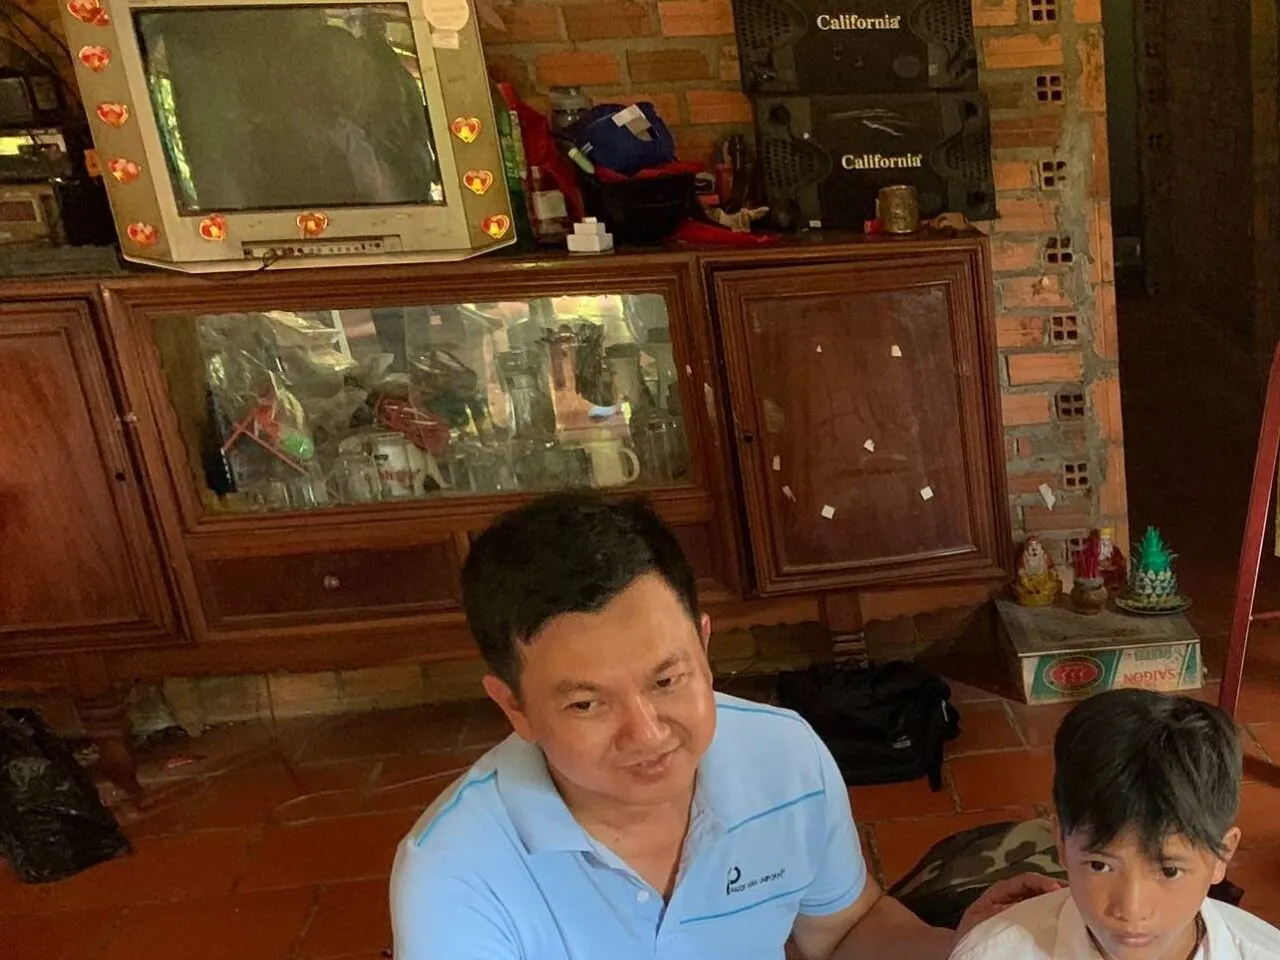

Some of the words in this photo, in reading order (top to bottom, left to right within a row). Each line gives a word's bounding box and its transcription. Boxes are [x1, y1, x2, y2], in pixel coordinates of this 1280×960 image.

[816, 14, 900, 31] California
[841, 153, 922, 170] California
[1123, 668, 1176, 685] SAIGON
